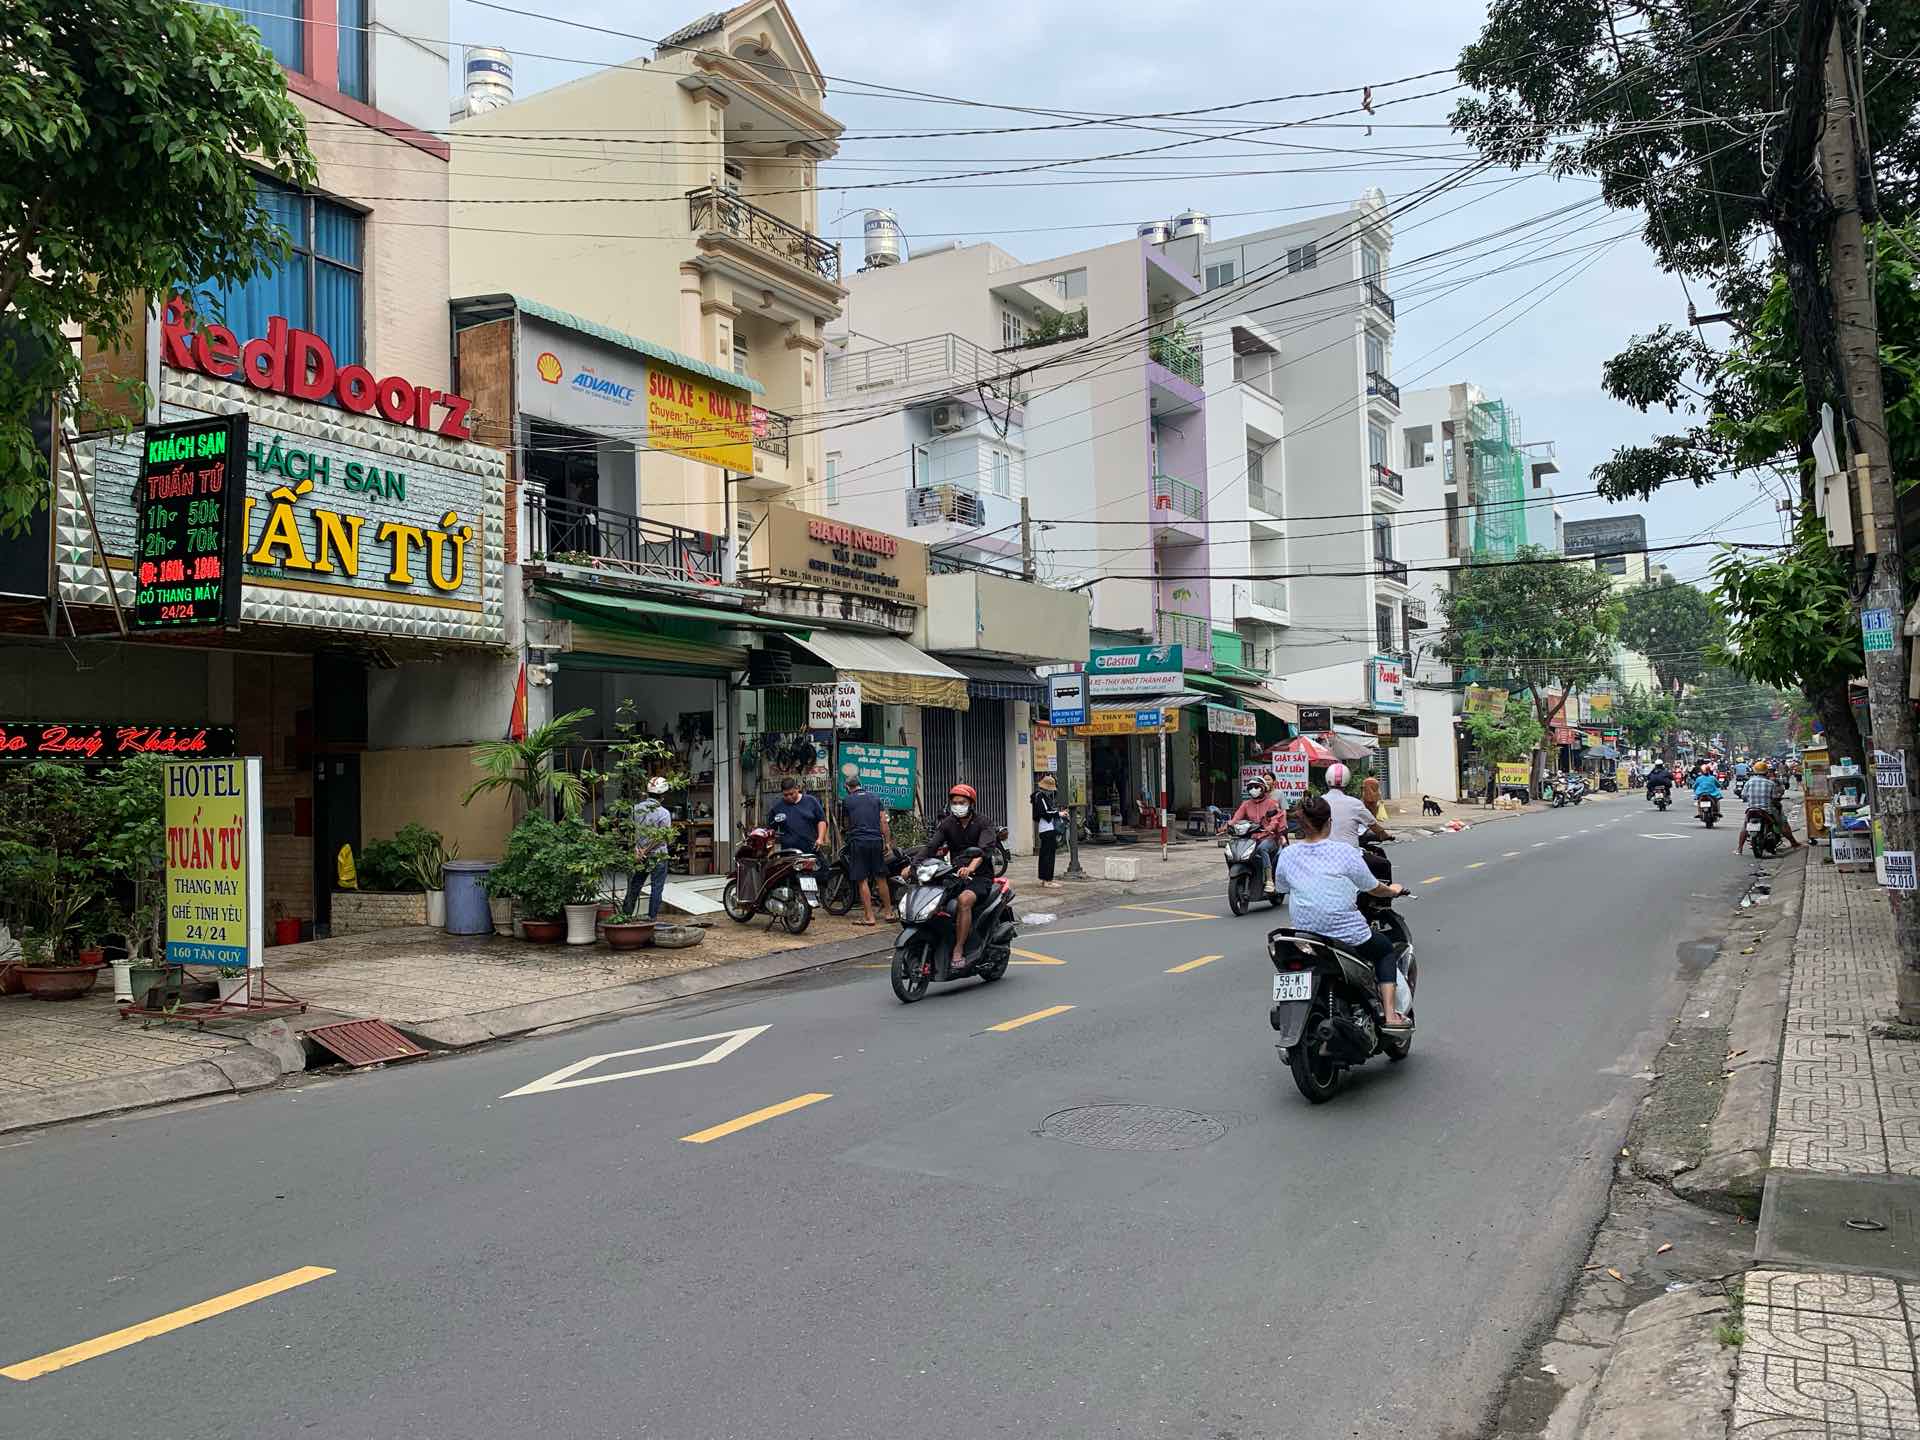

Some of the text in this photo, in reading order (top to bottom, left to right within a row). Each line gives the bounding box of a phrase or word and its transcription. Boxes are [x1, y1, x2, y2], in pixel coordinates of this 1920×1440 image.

[161, 295, 473, 440] RedDoorz
[572, 373, 635, 402] ADVANCE
[679, 381, 694, 408] XE
[149, 431, 226, 464] KHÁCH SẠN
[148, 462, 225, 500] TUẤN TỨ
[246, 435, 406, 502] HÁCH SẠN
[187, 498, 221, 525] 50k
[186, 526, 219, 553] 70k
[375, 510, 474, 591] TỨ
[140, 582, 219, 604] CÓ THANG MÁY
[161, 604, 194, 619] 24/24
[1105, 655, 1137, 667] Castrol
[39, 726, 104, 757] Quý
[116, 728, 207, 752] Khách
[169, 764, 241, 797] HOTEL
[1295, 781, 1307, 789] XE
[168, 806, 243, 871] TUẤN TỨ
[174, 875, 239, 896] THANG MÁY
[171, 899, 192, 919] GHẾ
[221, 903, 242, 923] YÊU
[186, 924, 227, 942] 24/24
[173, 946, 191, 958] 160
